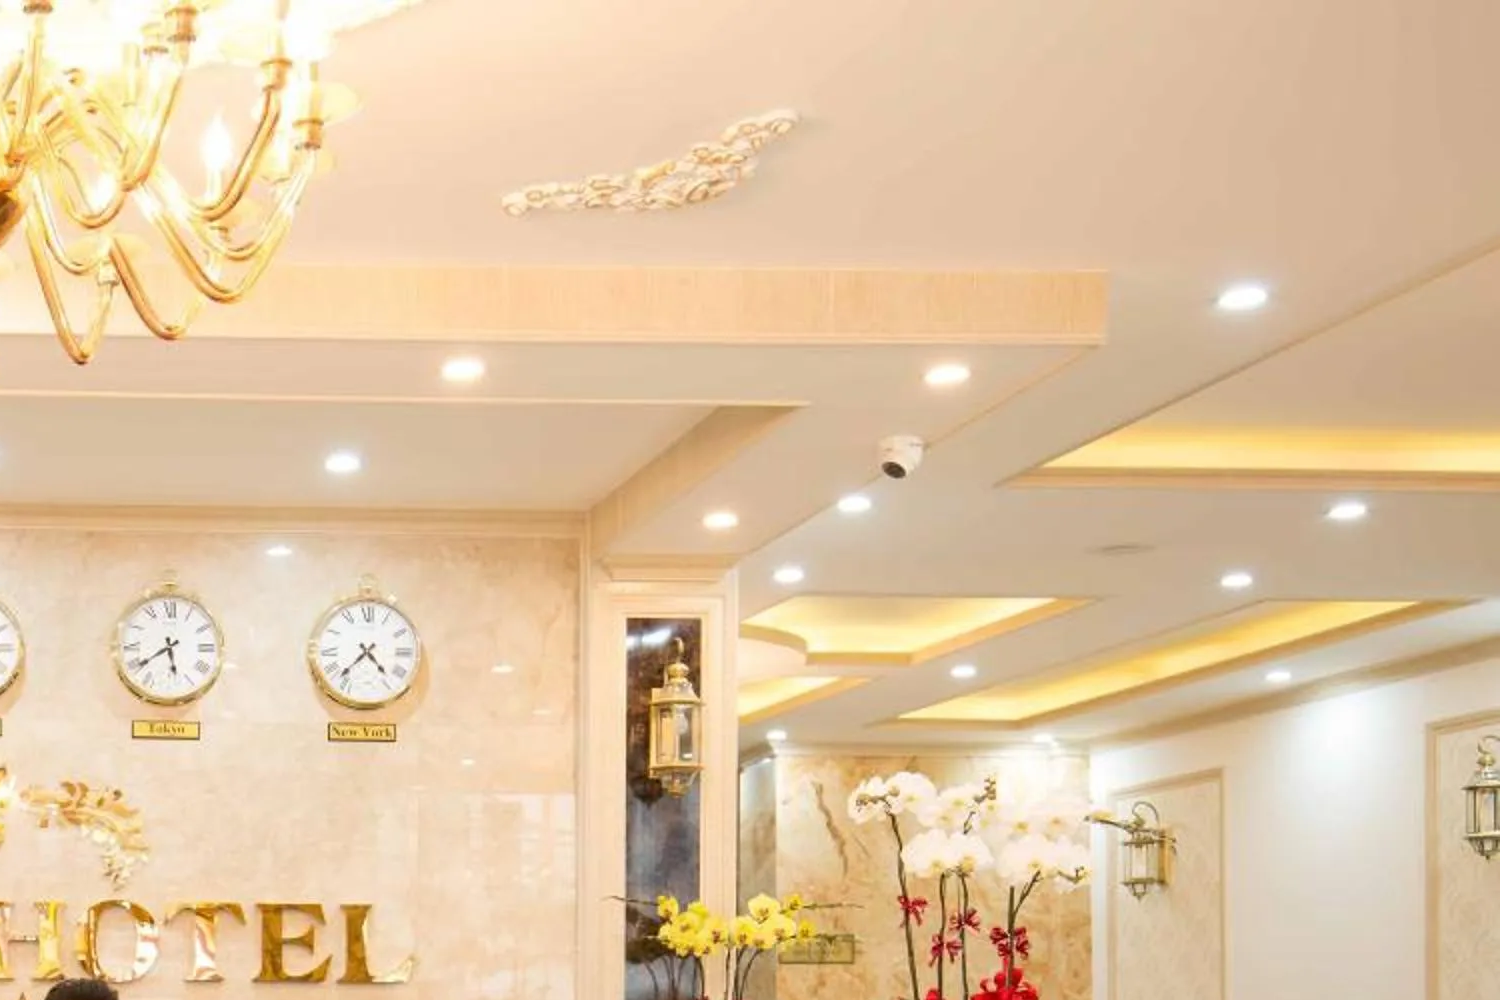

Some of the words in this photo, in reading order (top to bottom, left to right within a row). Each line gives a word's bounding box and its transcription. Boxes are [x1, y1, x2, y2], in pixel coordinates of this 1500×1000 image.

[148, 723, 186, 736] Tokyo
[332, 727, 358, 737] New
[363, 727, 392, 737] York
